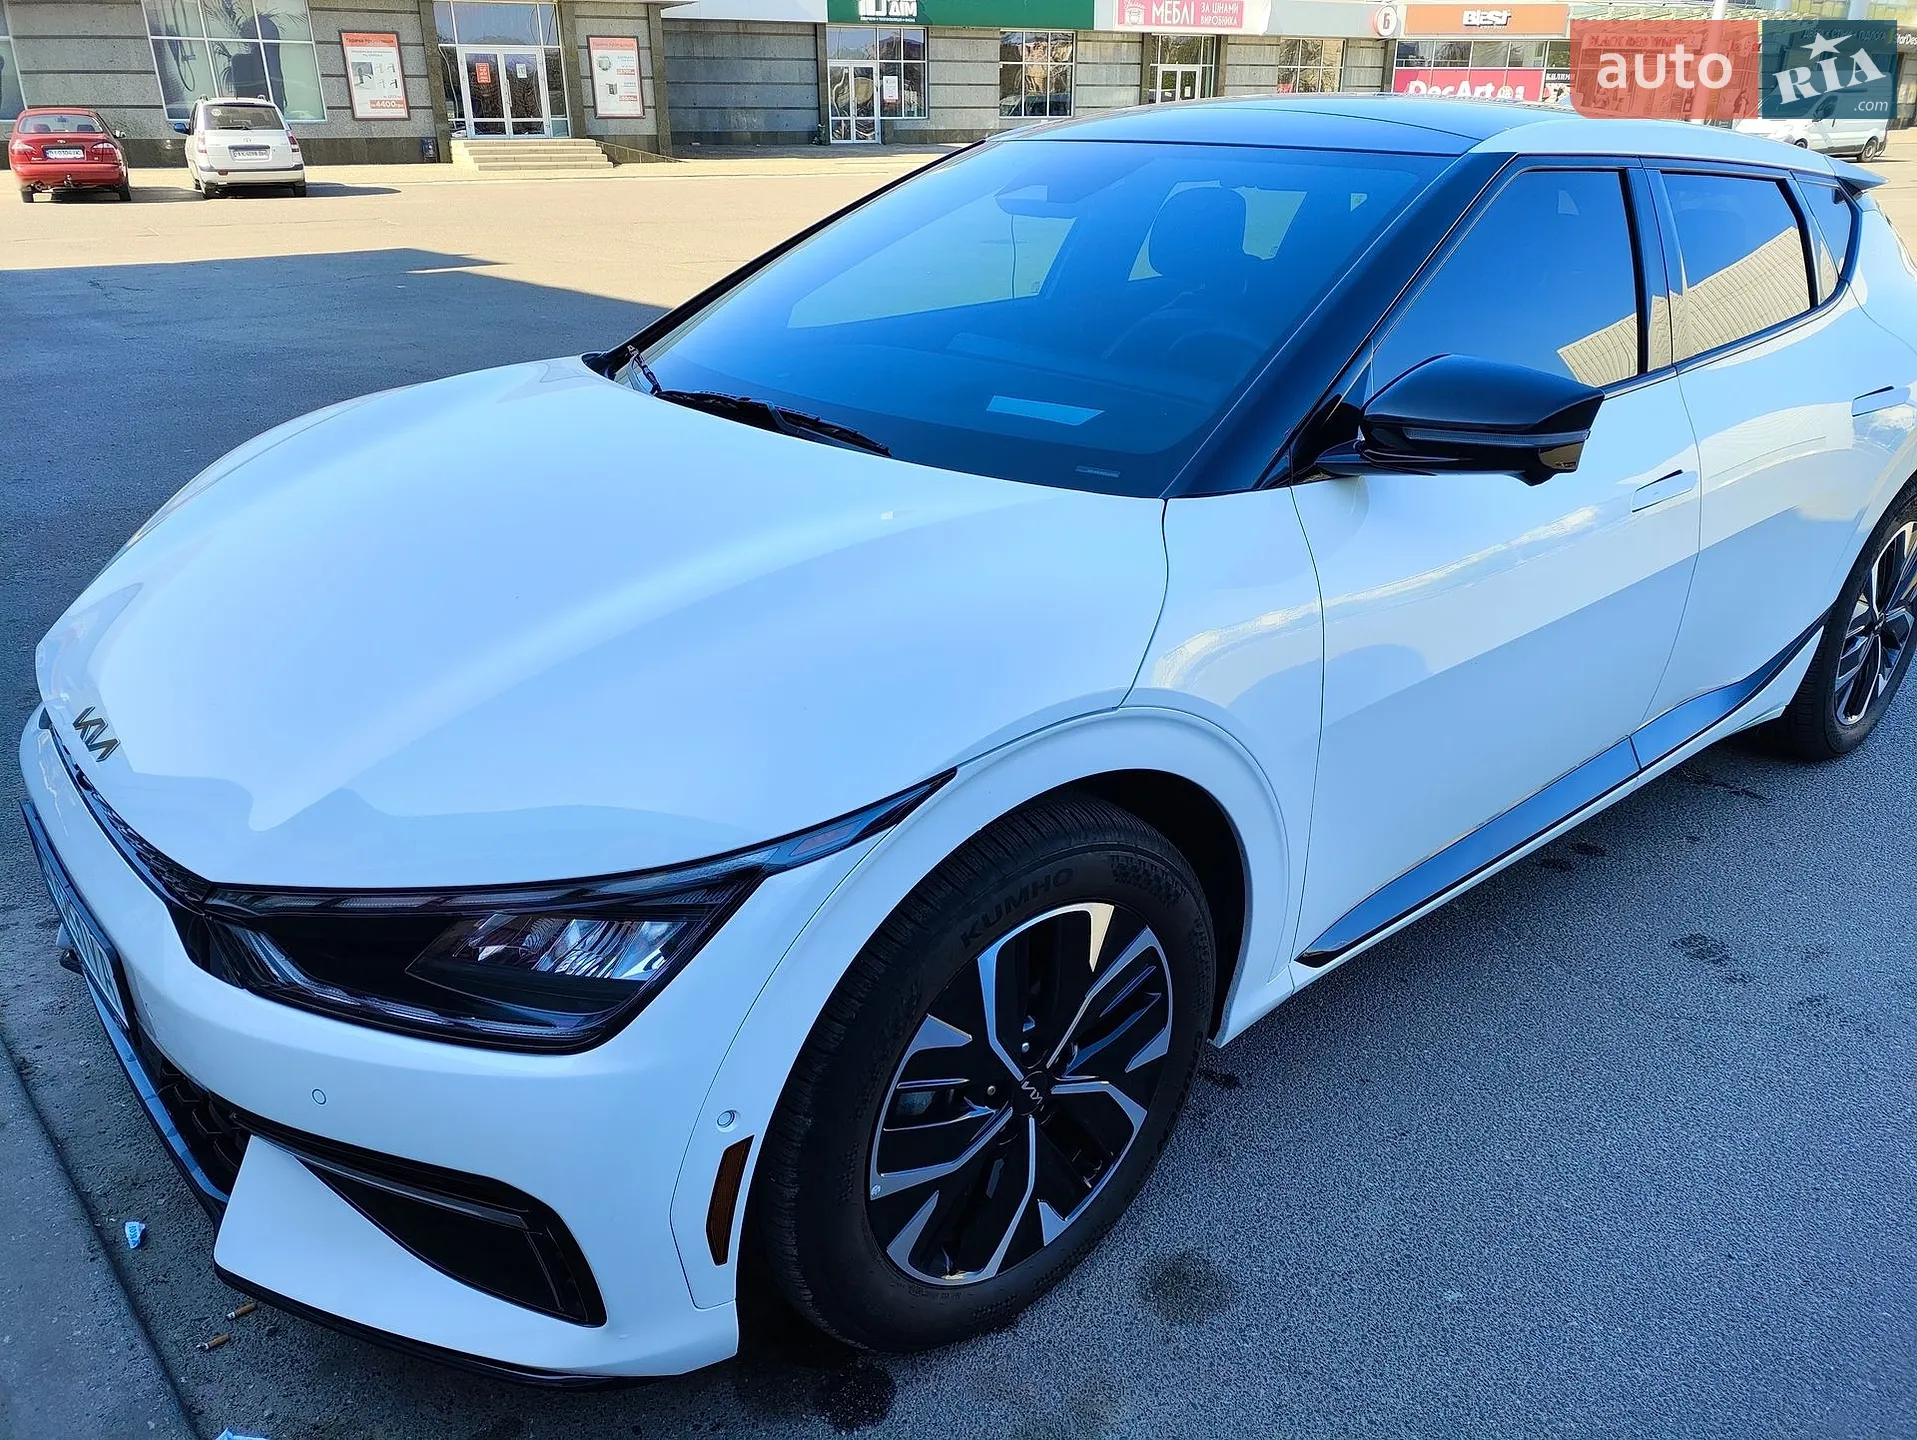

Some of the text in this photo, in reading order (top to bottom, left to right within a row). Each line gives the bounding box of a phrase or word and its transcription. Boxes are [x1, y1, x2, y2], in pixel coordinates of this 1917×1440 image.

[1151, 0, 1195, 25] МЕБЛІ
[1200, 15, 1238, 26] ВИРОБНИКА
[1201, 2, 1239, 14] ЗА ЦІНАМИ
[72, 704, 121, 763] KIA
[960, 868, 1074, 949] KUMHO
